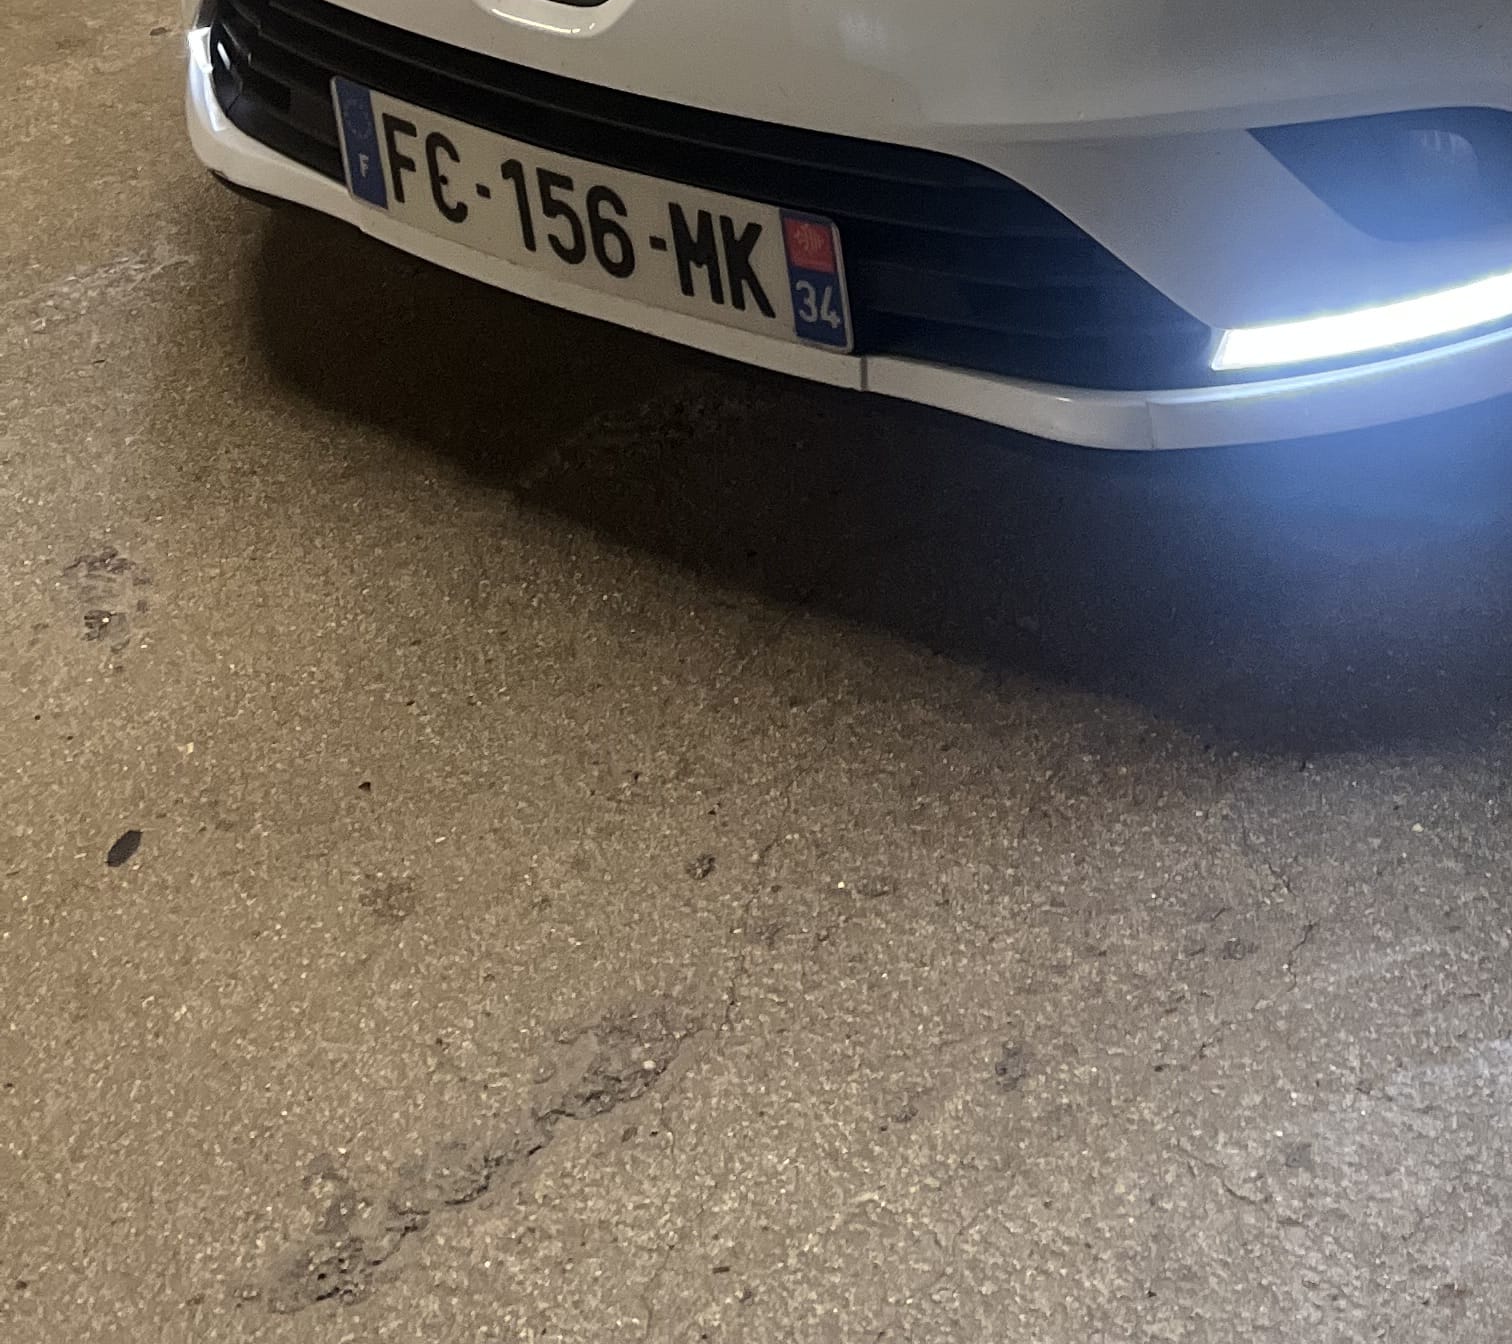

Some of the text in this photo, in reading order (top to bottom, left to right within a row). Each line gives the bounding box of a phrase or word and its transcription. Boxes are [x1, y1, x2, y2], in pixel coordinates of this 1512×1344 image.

[359, 152, 370, 178] F
[382, 112, 776, 318] FC-156-MK
[795, 279, 841, 329] 34
